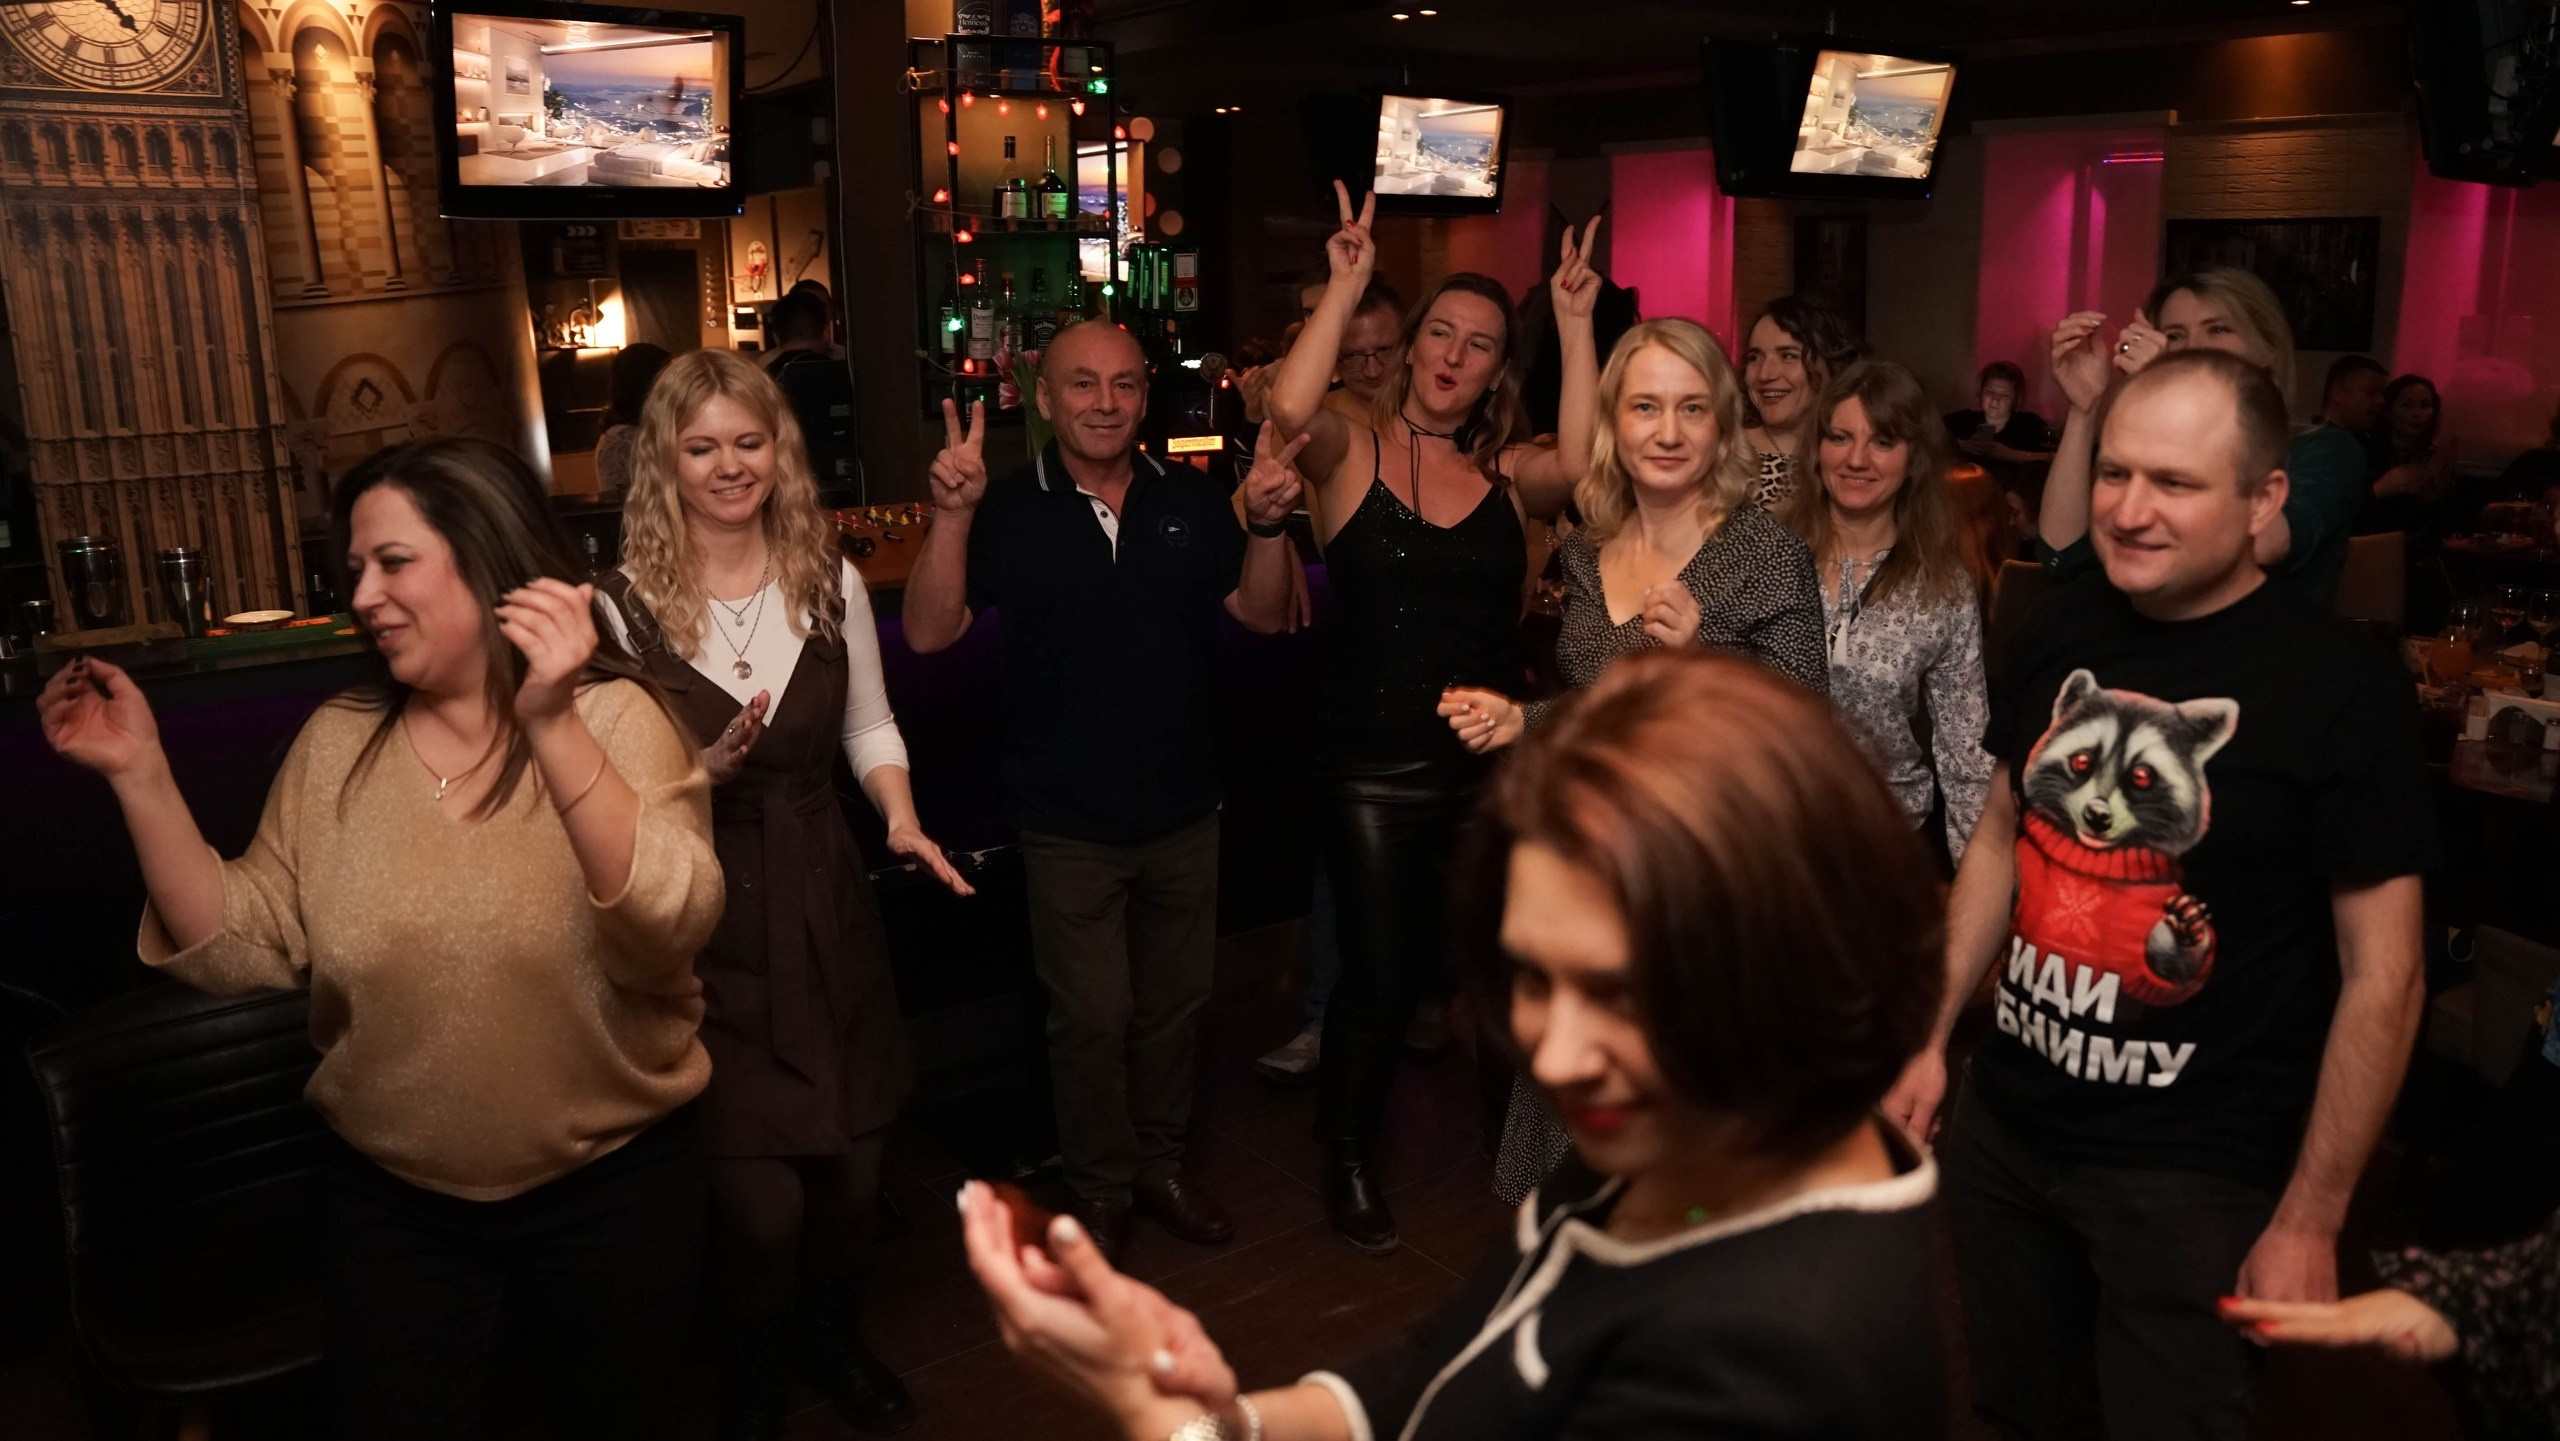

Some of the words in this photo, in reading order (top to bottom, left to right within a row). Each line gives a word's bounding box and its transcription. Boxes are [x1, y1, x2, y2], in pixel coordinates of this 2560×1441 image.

[959, 18, 988, 26] Hennessy
[2008, 935, 2120, 1024] ИДИ
[1994, 981, 2197, 1087] БНИМУ
